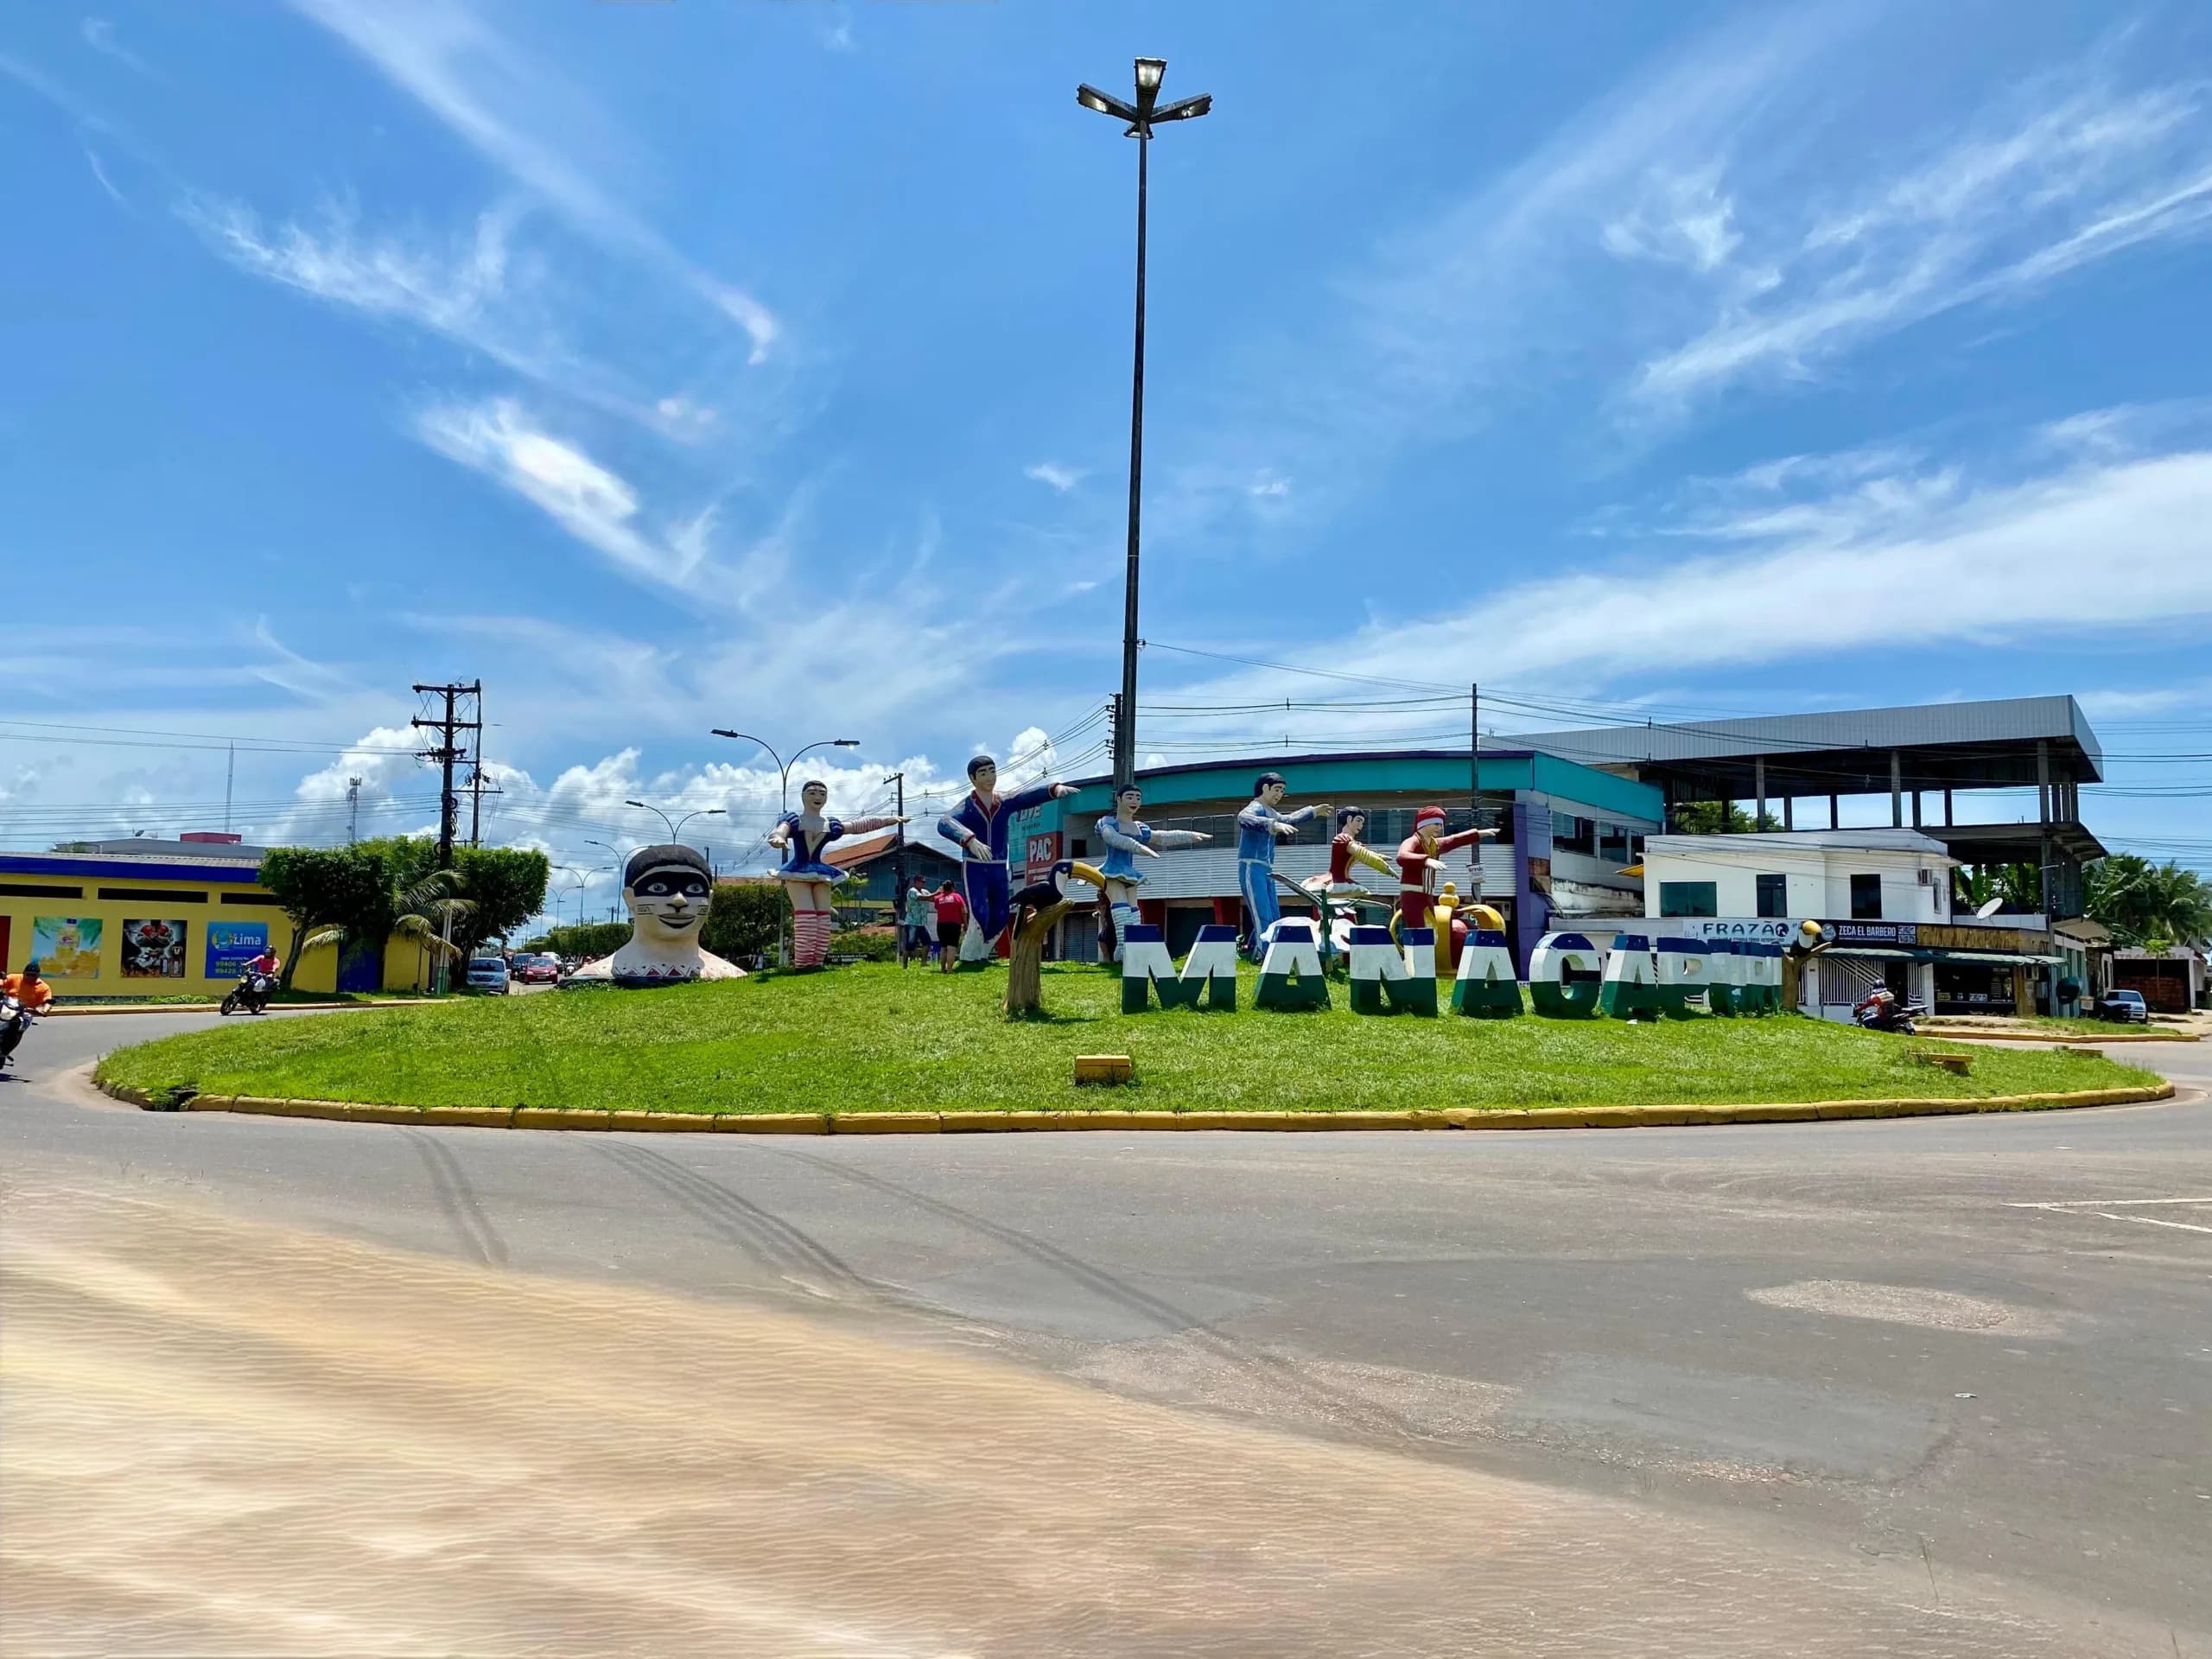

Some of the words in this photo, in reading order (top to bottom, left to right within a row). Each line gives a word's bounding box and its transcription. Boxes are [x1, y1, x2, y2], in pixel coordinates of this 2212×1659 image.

[1029, 837, 1052, 863] PAC
[1838, 925, 1856, 936] ZECA
[1857, 925, 1866, 937] EL
[1866, 926, 1897, 937] BARBERO
[233, 932, 262, 946] Lima
